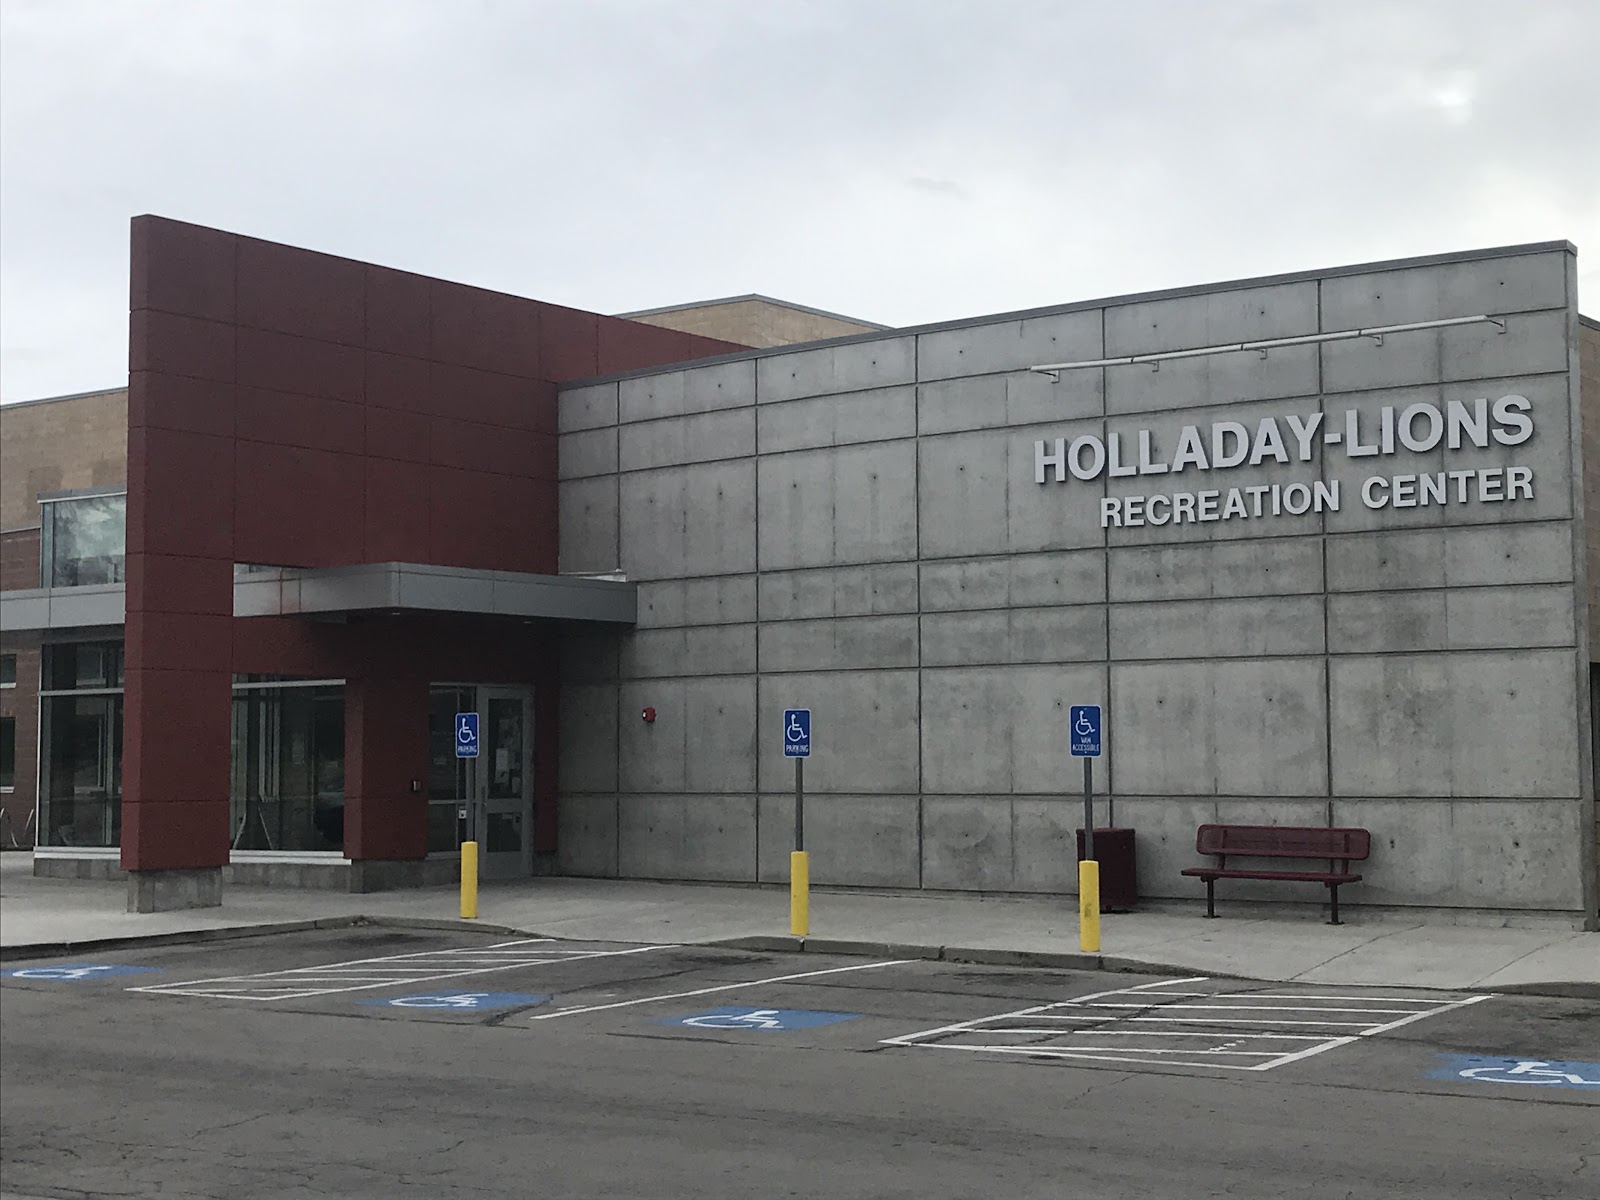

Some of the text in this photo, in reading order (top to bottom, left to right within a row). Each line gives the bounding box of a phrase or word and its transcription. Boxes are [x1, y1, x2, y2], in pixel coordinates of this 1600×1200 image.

[1034, 394, 1534, 484] HOLLADAY-LIONS
[1100, 466, 1534, 528] RECREATION CENTER
[457, 745, 477, 753] PARKING
[785, 744, 809, 753] PARKING
[1072, 743, 1100, 752] ACCESSIBLE
